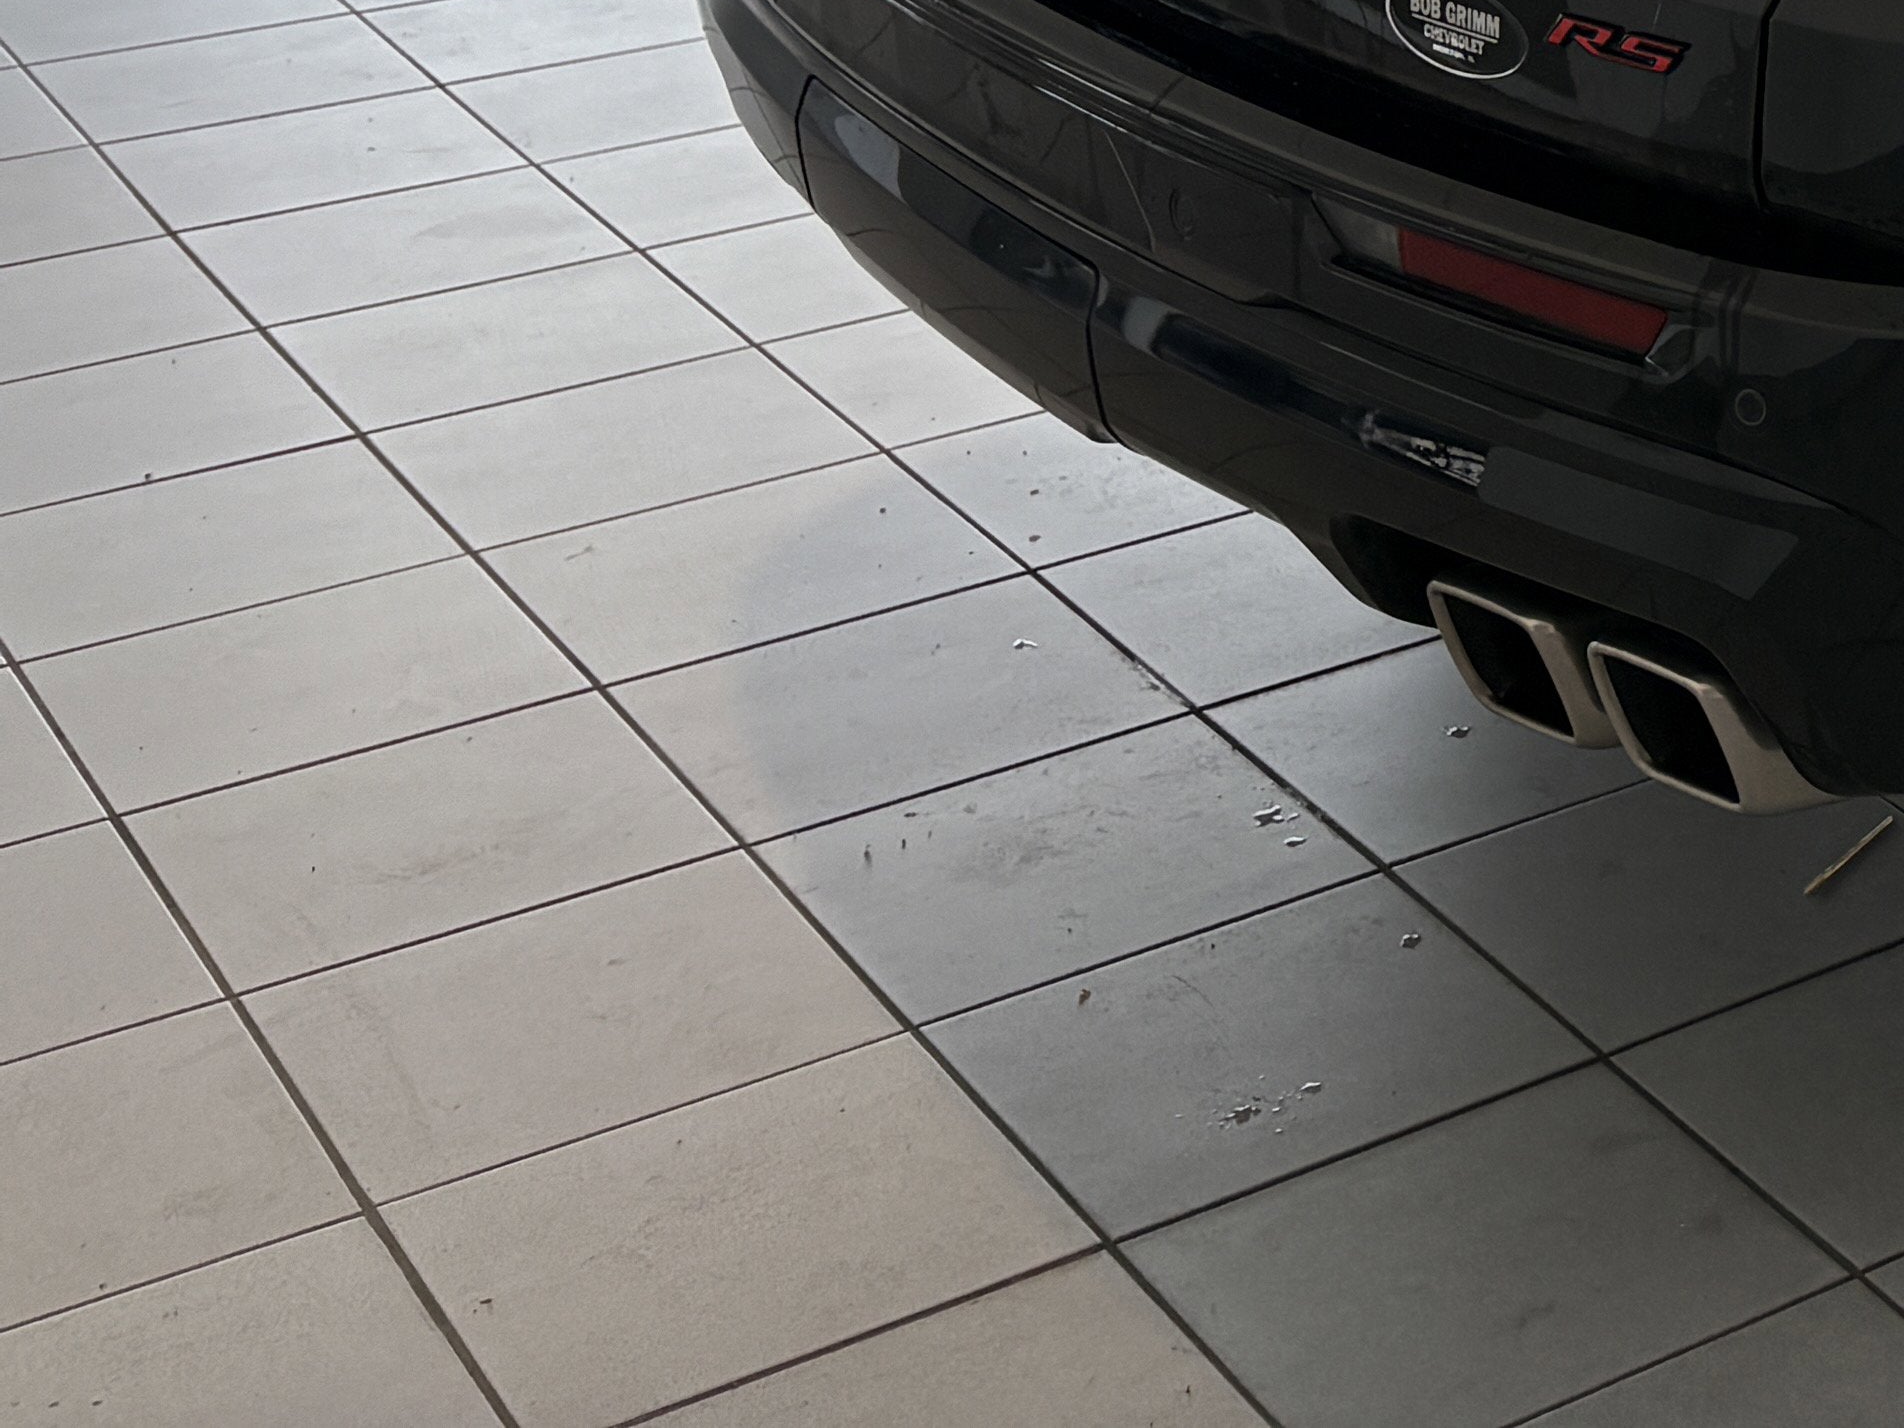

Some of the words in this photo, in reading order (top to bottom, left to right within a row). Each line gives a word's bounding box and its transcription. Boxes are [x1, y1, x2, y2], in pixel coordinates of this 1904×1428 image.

[1445, 1, 1500, 39] GRIMM
[1423, 23, 1485, 56] CHEVROLET
[1546, 13, 1691, 74] RS
